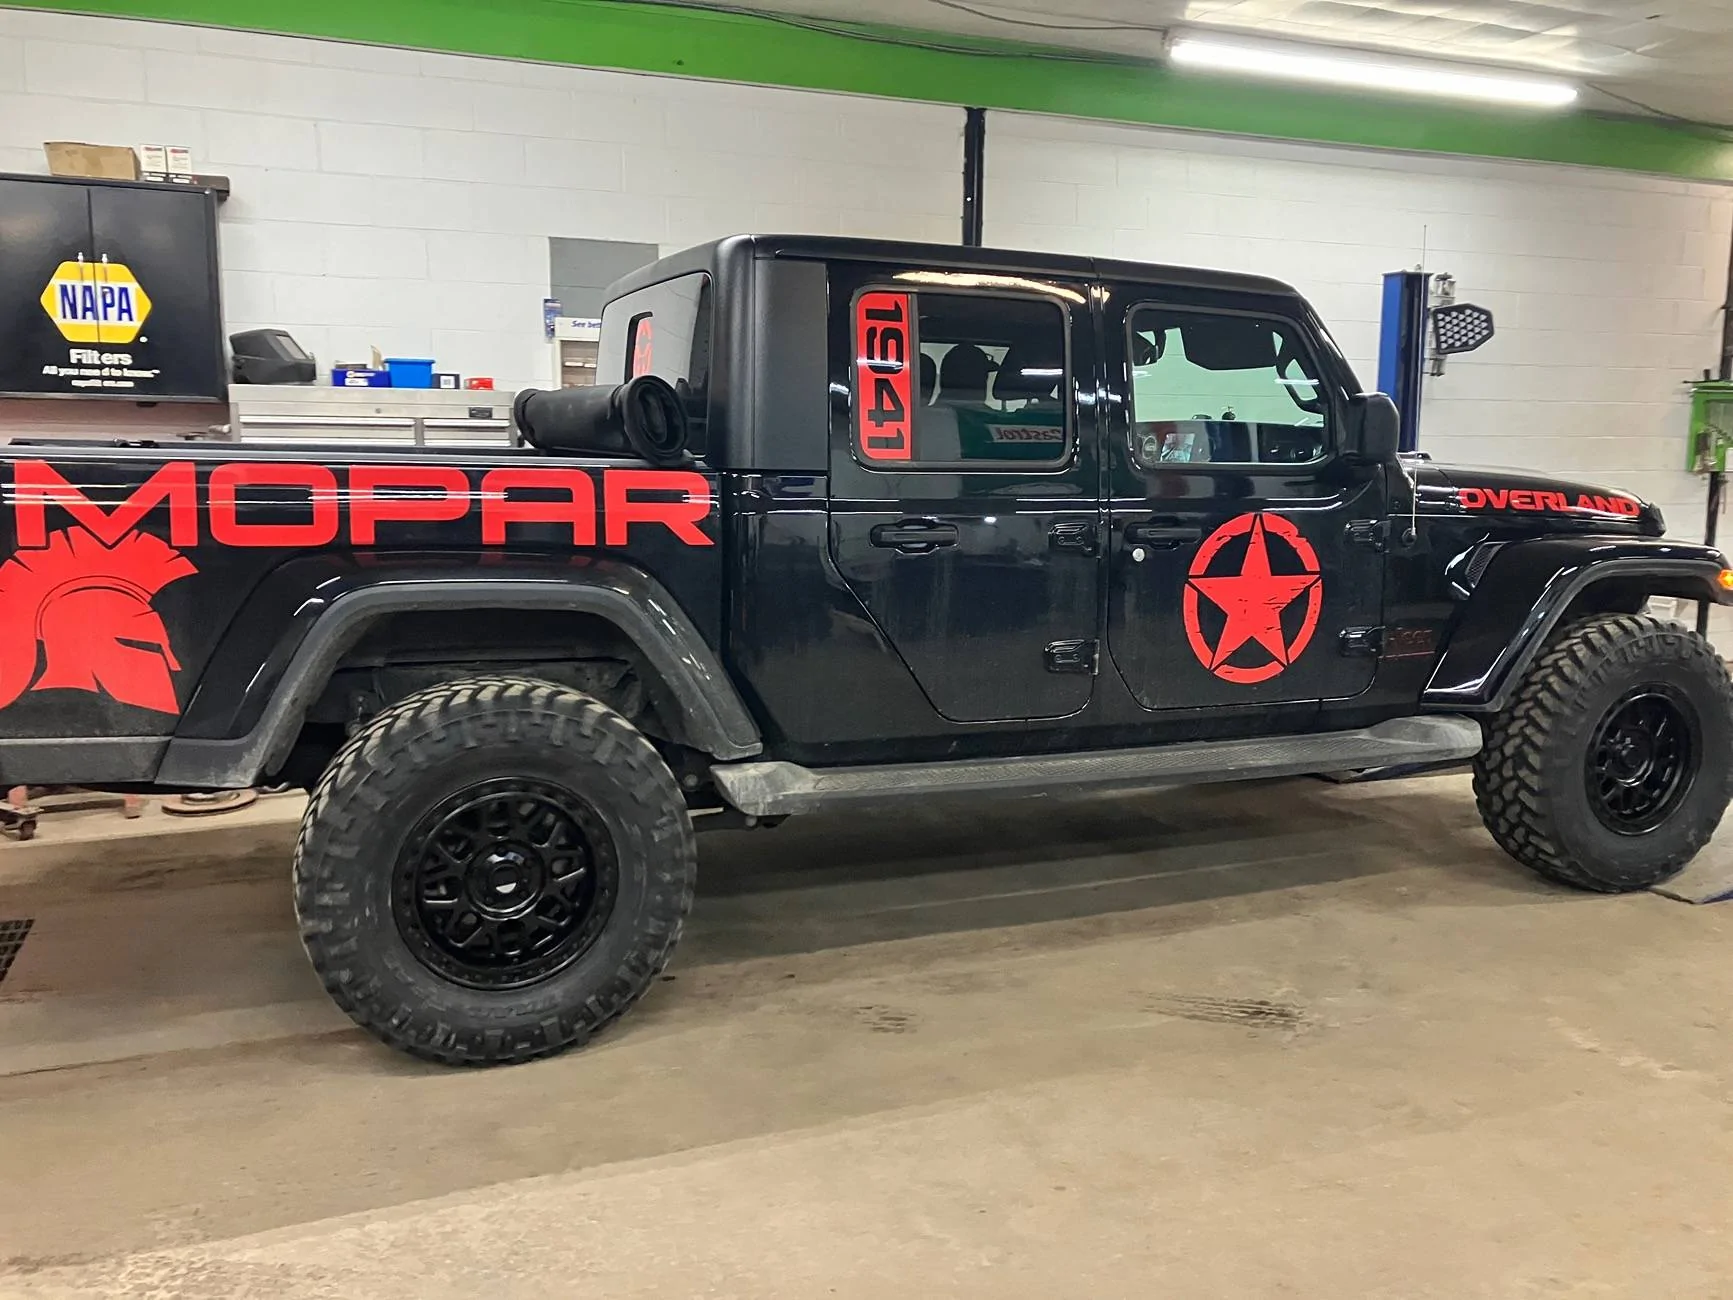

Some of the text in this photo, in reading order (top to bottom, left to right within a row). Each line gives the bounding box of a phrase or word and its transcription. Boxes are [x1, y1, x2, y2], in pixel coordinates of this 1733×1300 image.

[60, 284, 133, 321] NAPA
[69, 348, 133, 365] Filters
[866, 300, 905, 450] 1941
[13, 459, 714, 548] MOPAR
[1457, 487, 1641, 516] OVERLAND
